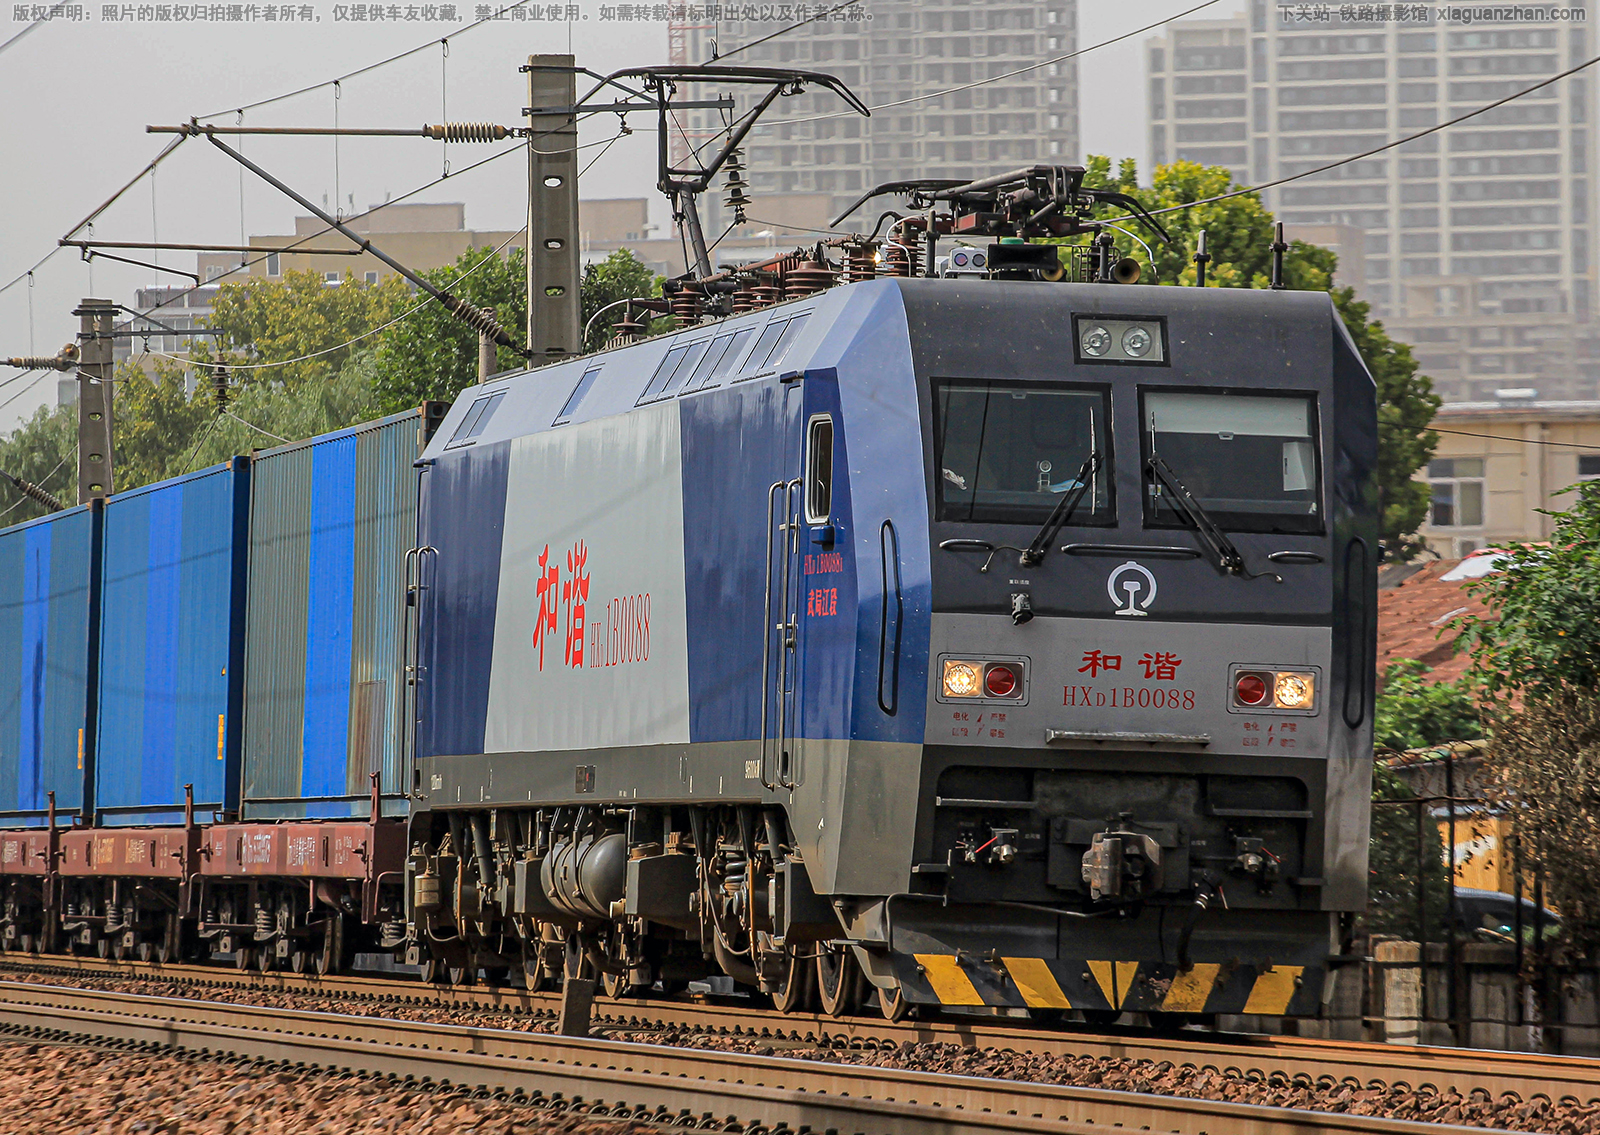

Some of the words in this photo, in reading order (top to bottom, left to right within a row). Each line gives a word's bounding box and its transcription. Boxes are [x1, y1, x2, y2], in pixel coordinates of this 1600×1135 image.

[532, 538, 591, 672] 和谐
[1077, 649, 1183, 681] 和谐
[1062, 685, 1196, 711] HXD1B0088
